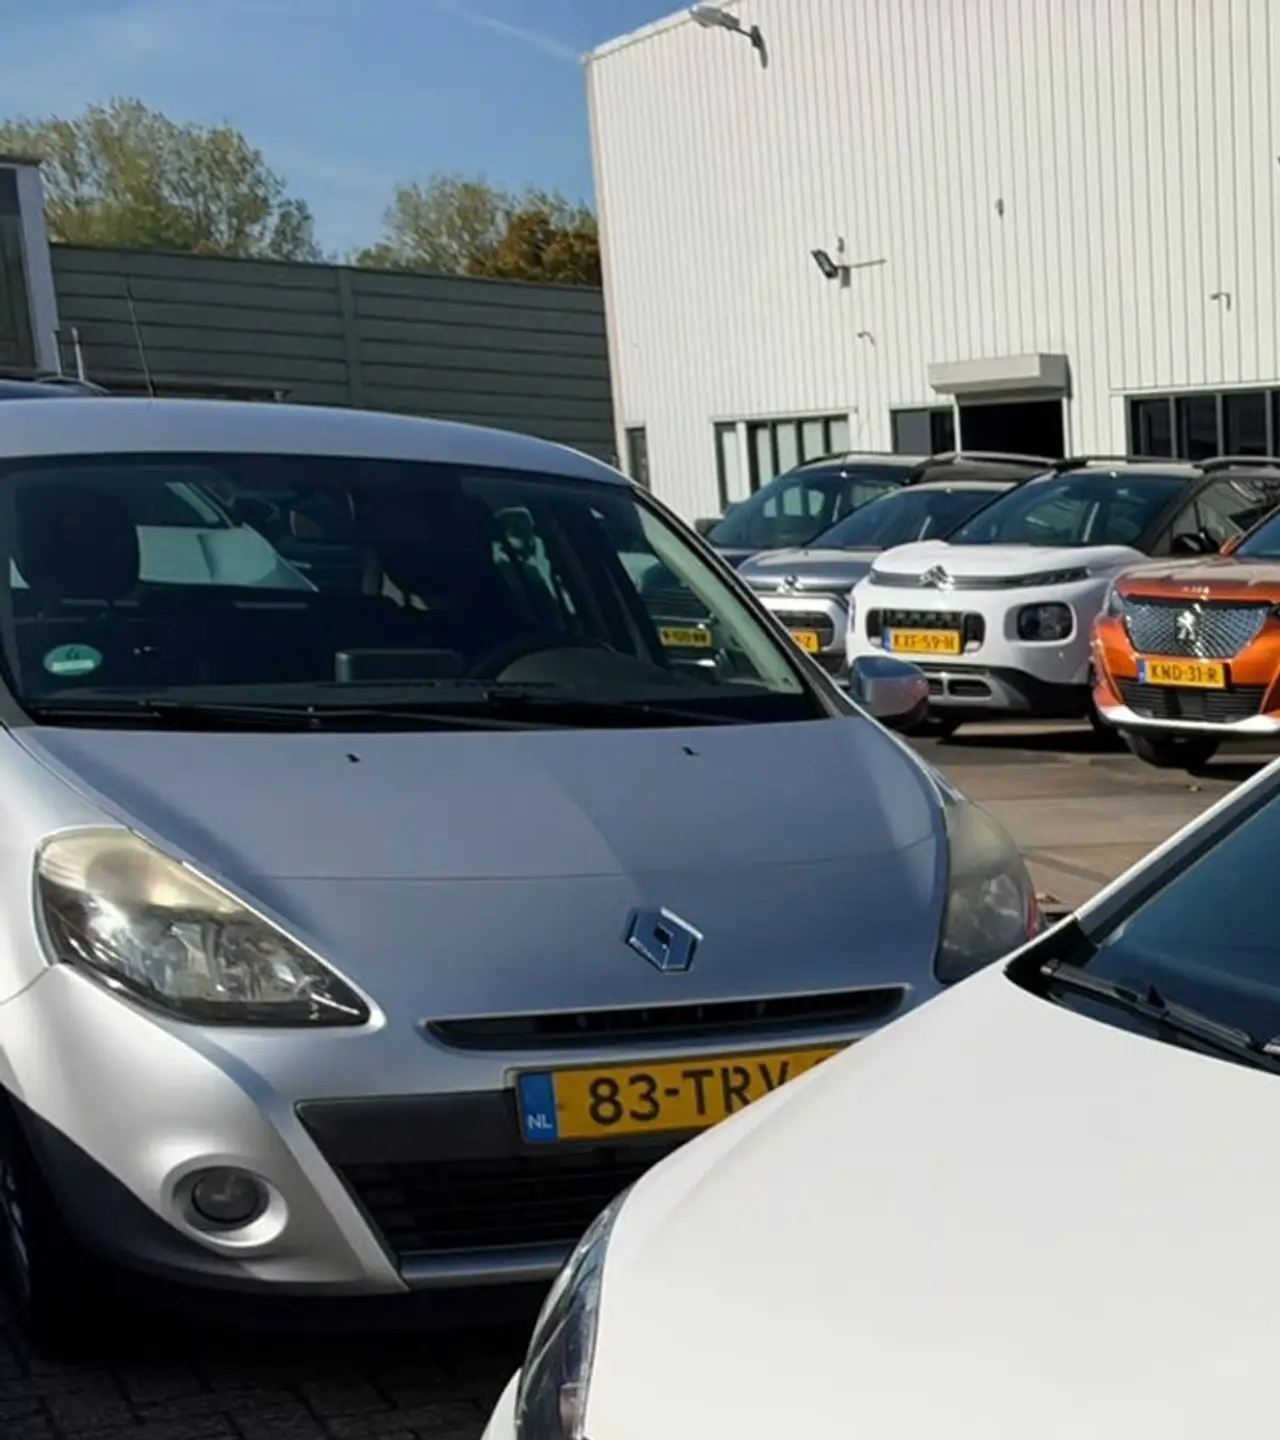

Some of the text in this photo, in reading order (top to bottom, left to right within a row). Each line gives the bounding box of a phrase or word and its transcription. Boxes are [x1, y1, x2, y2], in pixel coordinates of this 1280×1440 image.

[1150, 663, 1220, 684] KND-31-R
[588, 1058, 826, 1127] 83-TRV
[526, 1114, 553, 1130] NL
